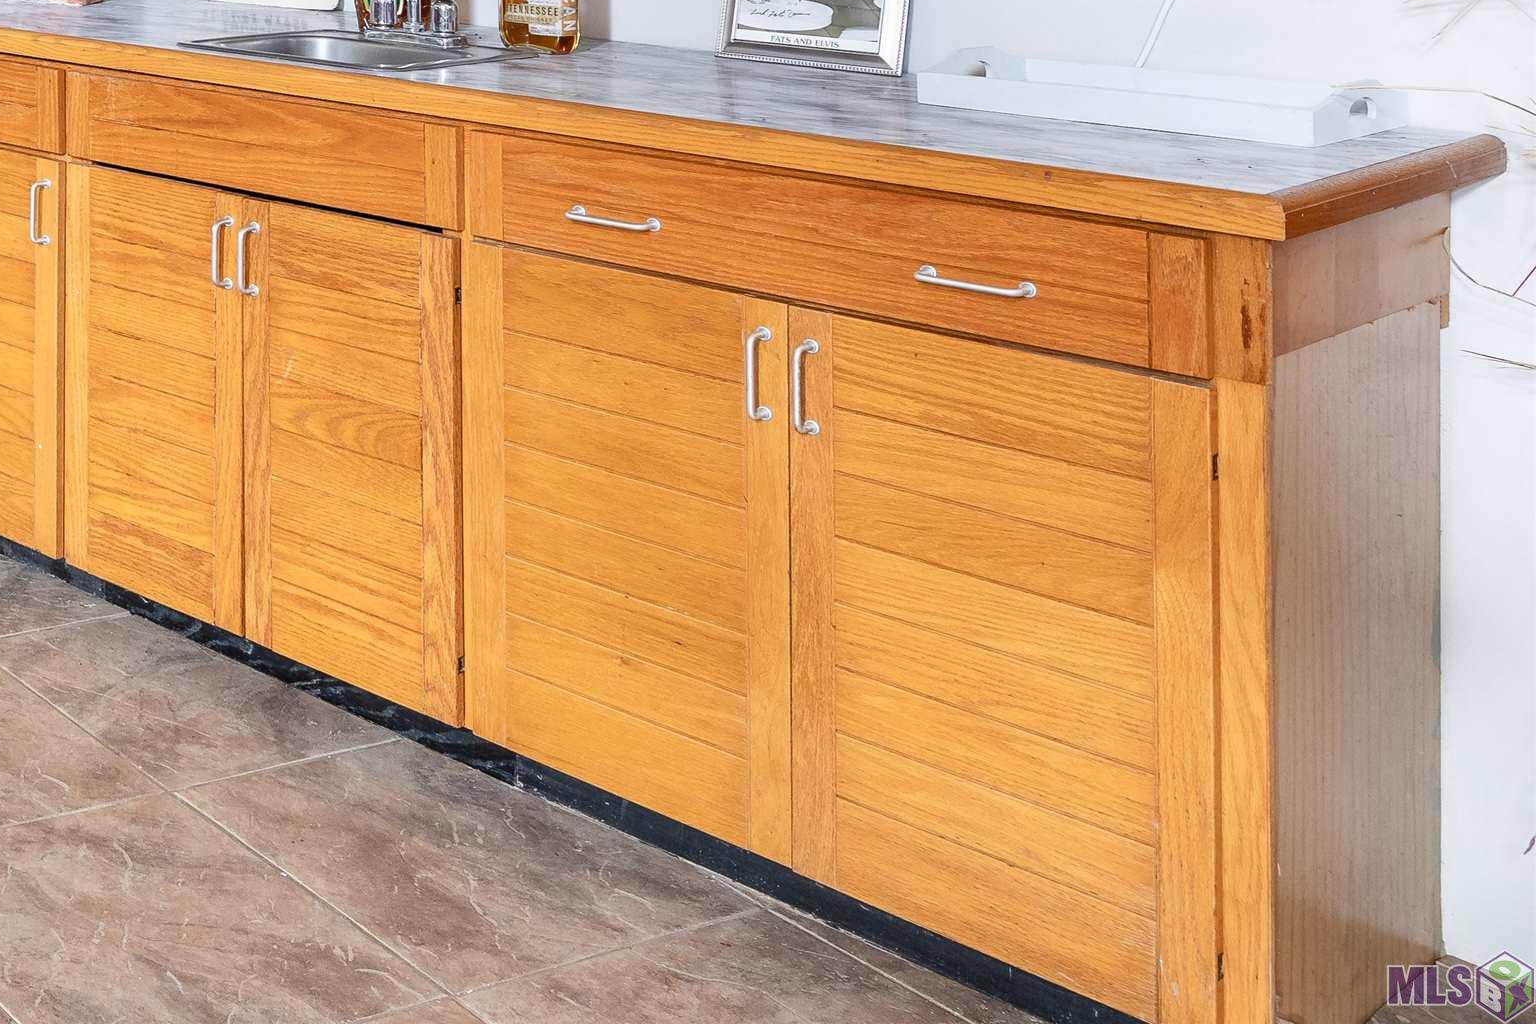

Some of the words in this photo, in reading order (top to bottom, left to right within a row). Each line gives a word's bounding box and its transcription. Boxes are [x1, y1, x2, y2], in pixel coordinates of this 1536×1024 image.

[509, 3, 560, 17] TENNESSEE
[769, 35, 791, 44] FATS
[793, 38, 813, 46] AND
[815, 40, 840, 49] ELVIS
